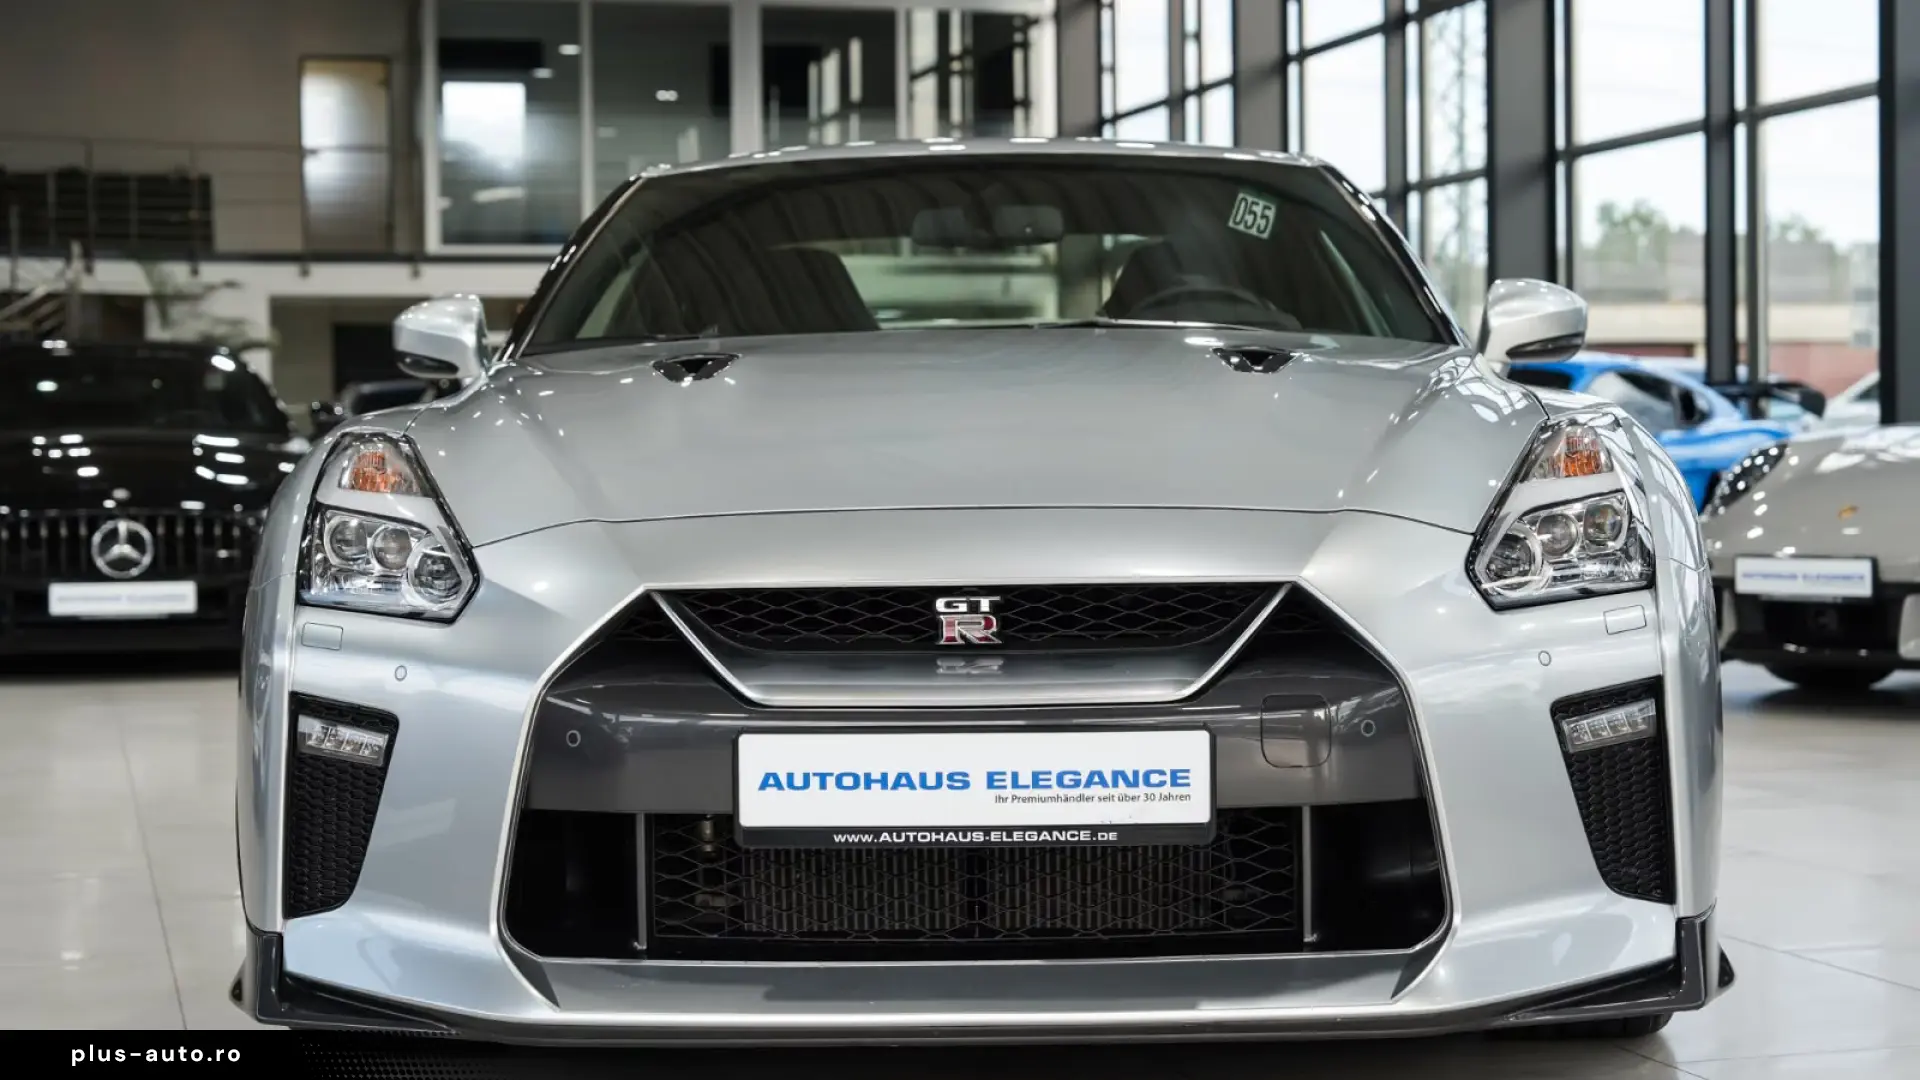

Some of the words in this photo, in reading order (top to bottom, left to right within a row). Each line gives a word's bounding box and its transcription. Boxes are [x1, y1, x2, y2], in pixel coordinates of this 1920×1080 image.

[1232, 197, 1273, 234] 055
[935, 596, 1001, 613] GT
[935, 614, 1003, 645] R
[757, 770, 971, 792] AUTOHAUS
[986, 768, 1191, 790] ELEGANCE
[994, 794, 1008, 804] Ihr
[1010, 793, 1096, 804] Premiumhändler
[1097, 793, 1115, 803] seit
[1117, 792, 1140, 803] über
[1143, 792, 1156, 802] 30
[1158, 792, 1191, 802] Jahren
